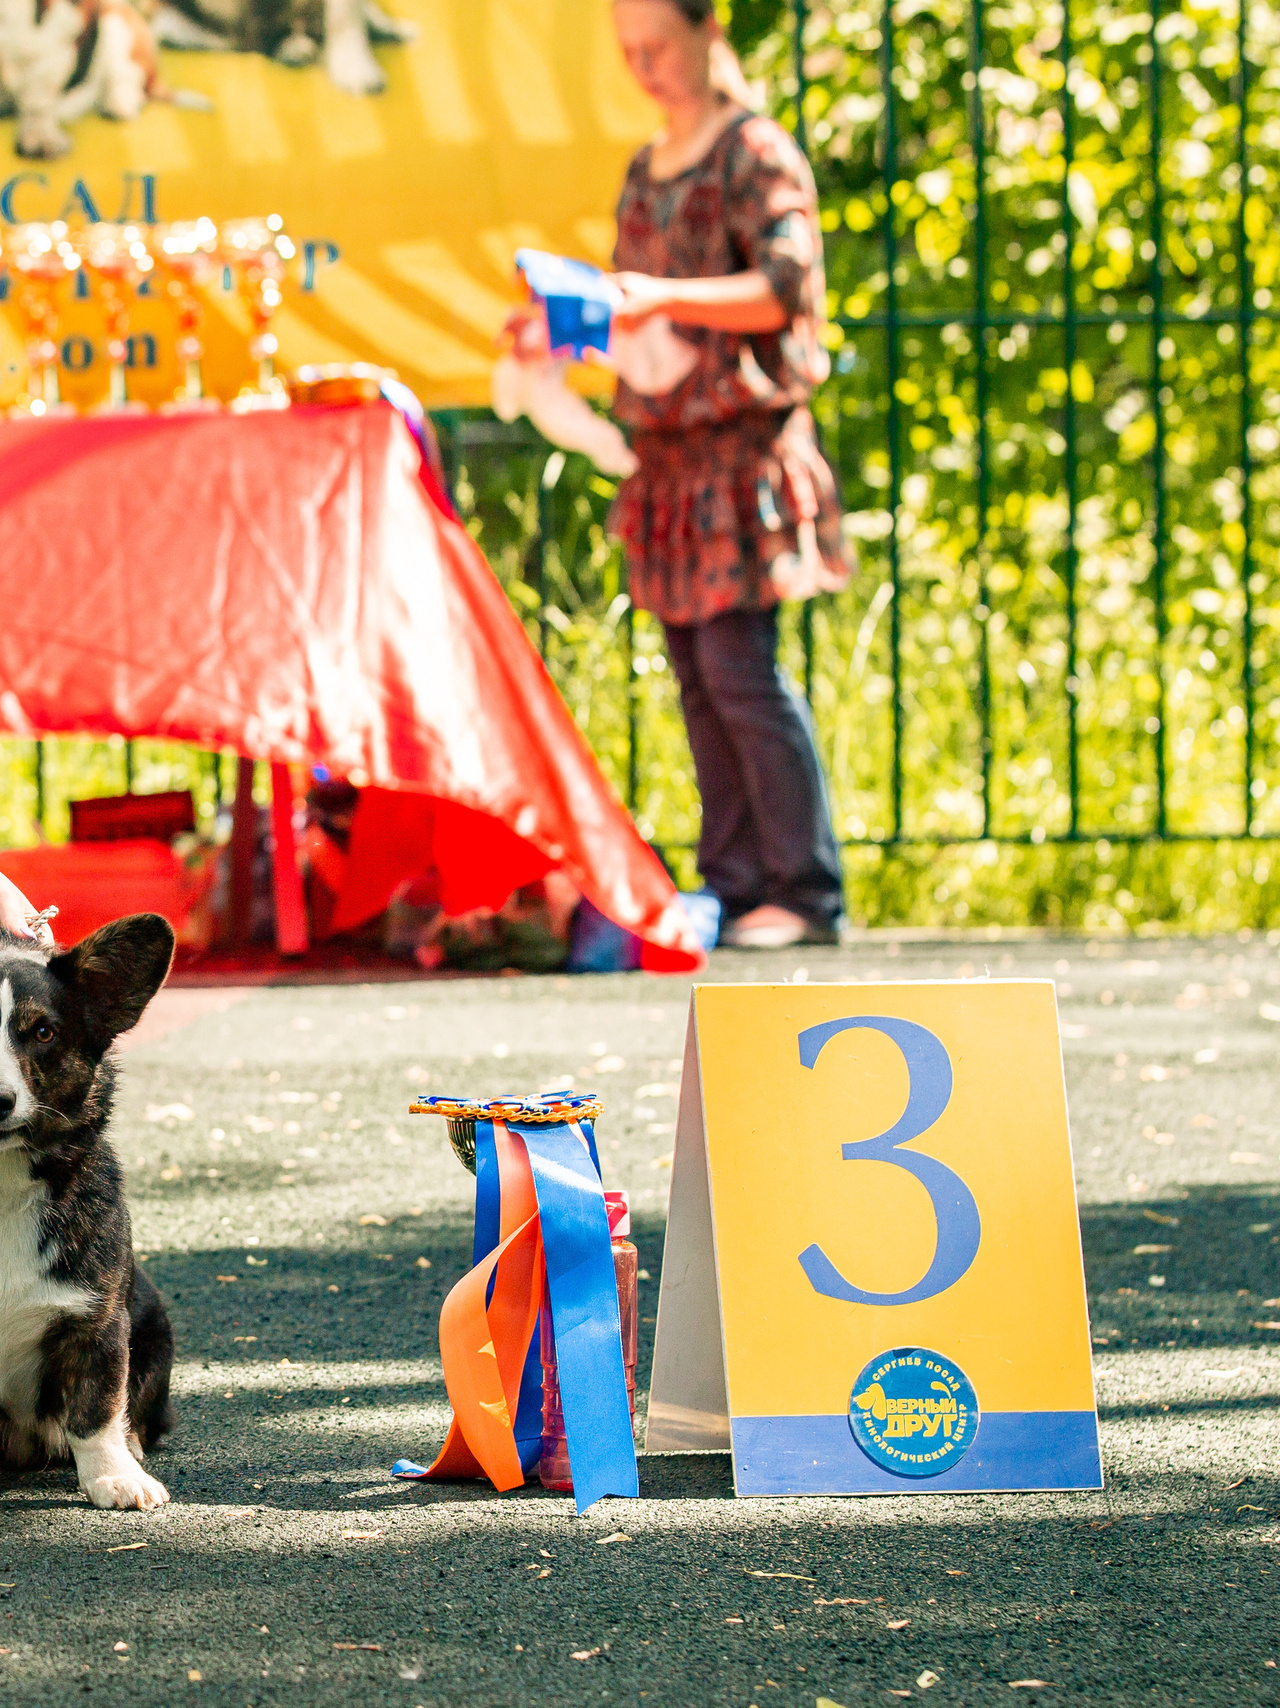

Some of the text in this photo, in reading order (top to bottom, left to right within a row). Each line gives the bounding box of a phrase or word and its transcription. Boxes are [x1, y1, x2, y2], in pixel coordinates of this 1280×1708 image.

[797, 1015, 981, 1306] 3
[872, 1357, 961, 1392] СЕРГИЕВ ПОСАД
[862, 1403, 967, 1463] КИНОЛОГИЧЕСКИЙ ЦЕНТР
[882, 1414, 958, 1437] ДРУГ
